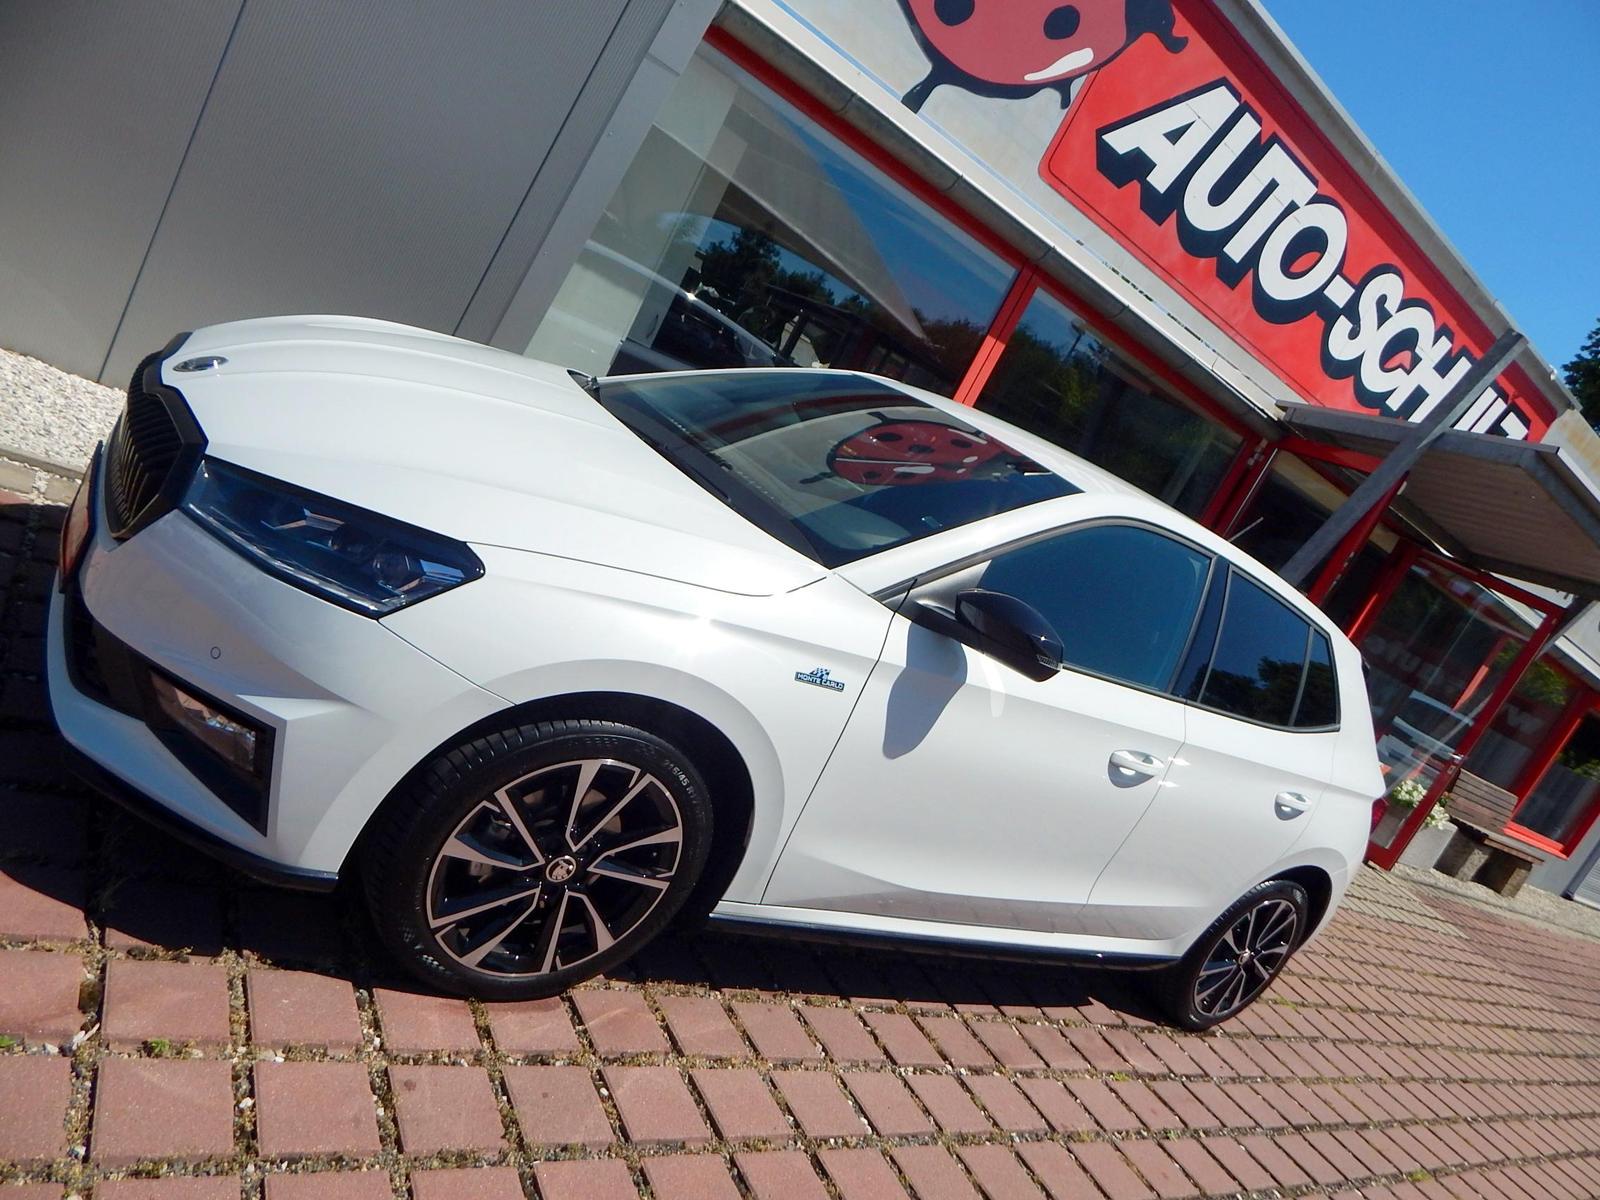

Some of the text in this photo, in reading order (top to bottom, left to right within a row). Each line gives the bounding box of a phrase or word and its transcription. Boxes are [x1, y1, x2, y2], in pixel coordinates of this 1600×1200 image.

[1101, 83, 1529, 441] AUTO-SCH
[797, 672, 844, 689] MONTE CARLO
